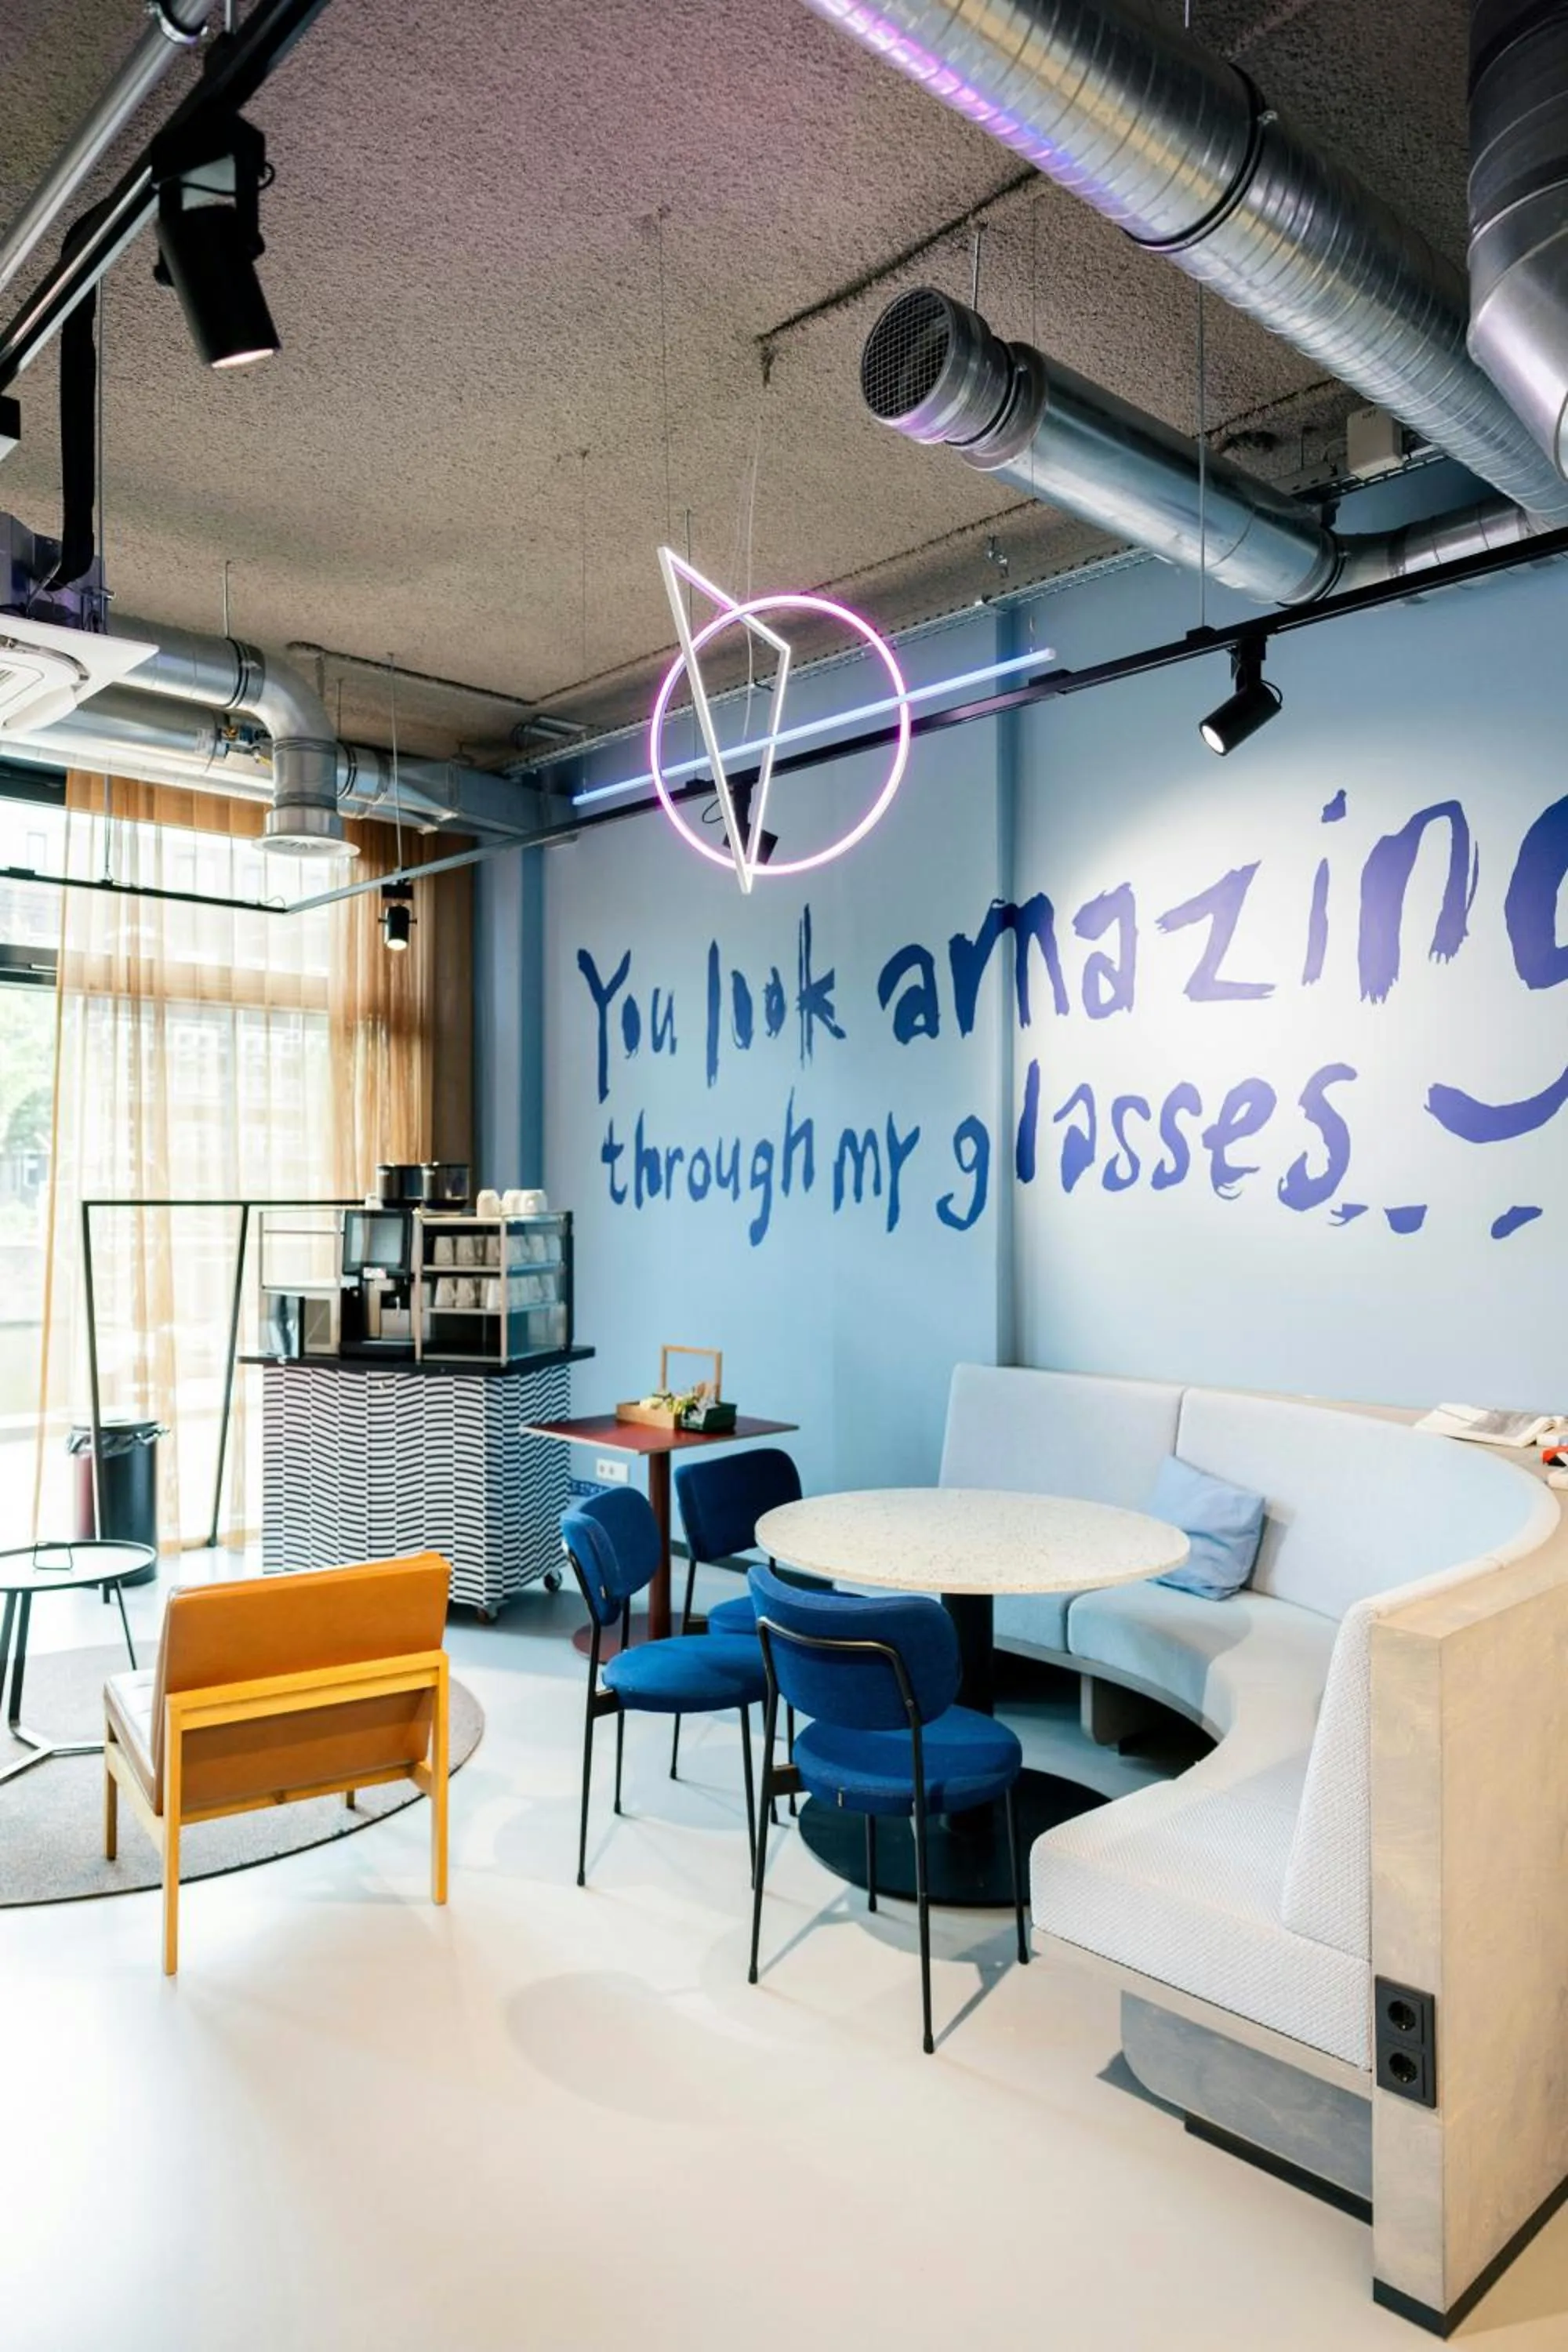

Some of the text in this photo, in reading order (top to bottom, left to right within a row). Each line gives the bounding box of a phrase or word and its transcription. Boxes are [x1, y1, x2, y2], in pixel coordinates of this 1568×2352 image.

[579, 949, 677, 1103] You
[706, 903, 846, 1089] look
[601, 1087, 815, 1247] through
[833, 1112, 920, 1232] my
